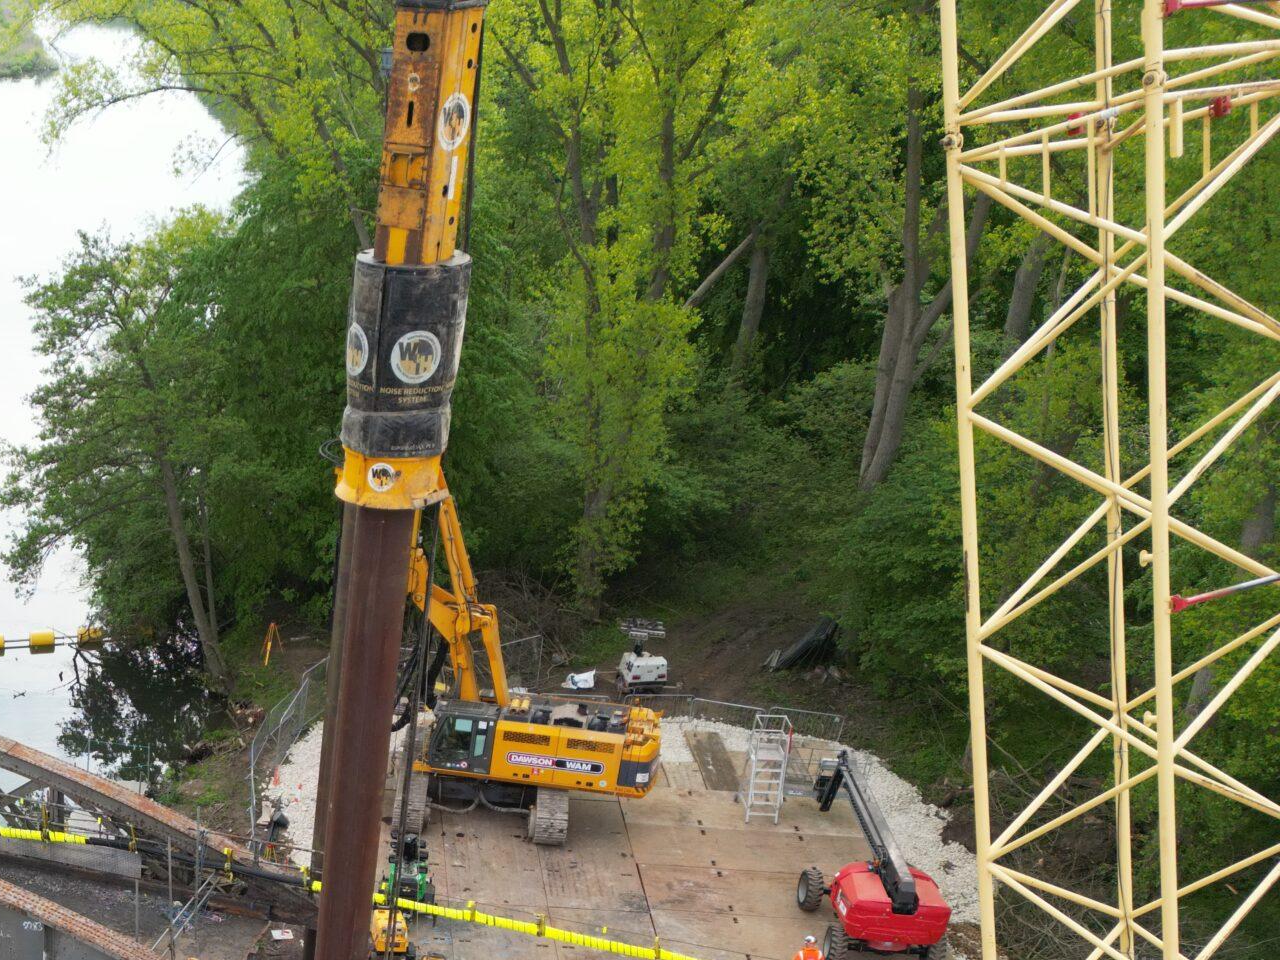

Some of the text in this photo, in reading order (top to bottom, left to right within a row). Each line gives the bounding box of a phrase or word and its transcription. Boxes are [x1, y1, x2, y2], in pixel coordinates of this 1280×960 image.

[380, 386, 403, 395] NOISE
[404, 384, 443, 395] REDUCTION
[511, 754, 592, 771] DAWSON WAM
